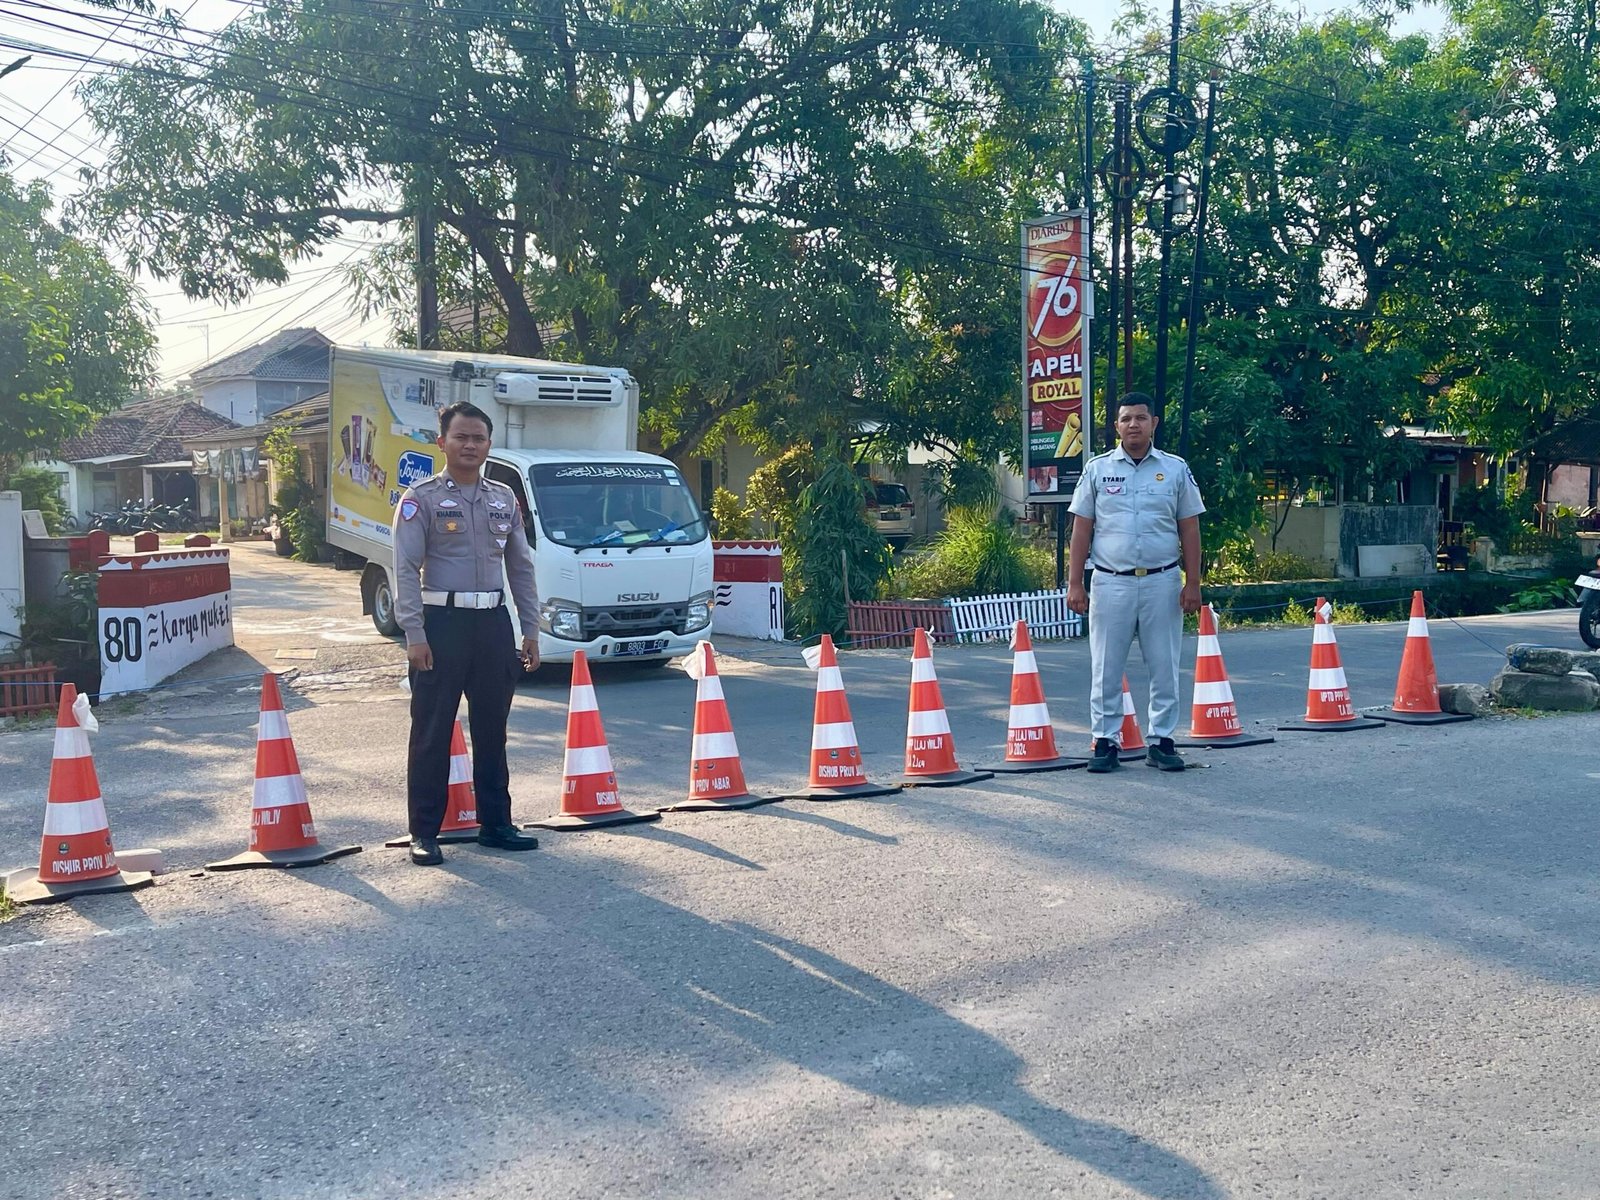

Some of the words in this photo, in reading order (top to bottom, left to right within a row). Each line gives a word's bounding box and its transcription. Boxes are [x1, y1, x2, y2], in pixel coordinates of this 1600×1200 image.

[1032, 255, 1078, 339] 76
[1030, 353, 1082, 378] APEL
[1037, 382, 1080, 399] ROYAL
[489, 512, 512, 520] POLRI
[617, 592, 660, 603] ISUZU
[104, 616, 142, 663] 80
[52, 859, 82, 876] DISHUB
[82, 854, 103, 872] PROV
